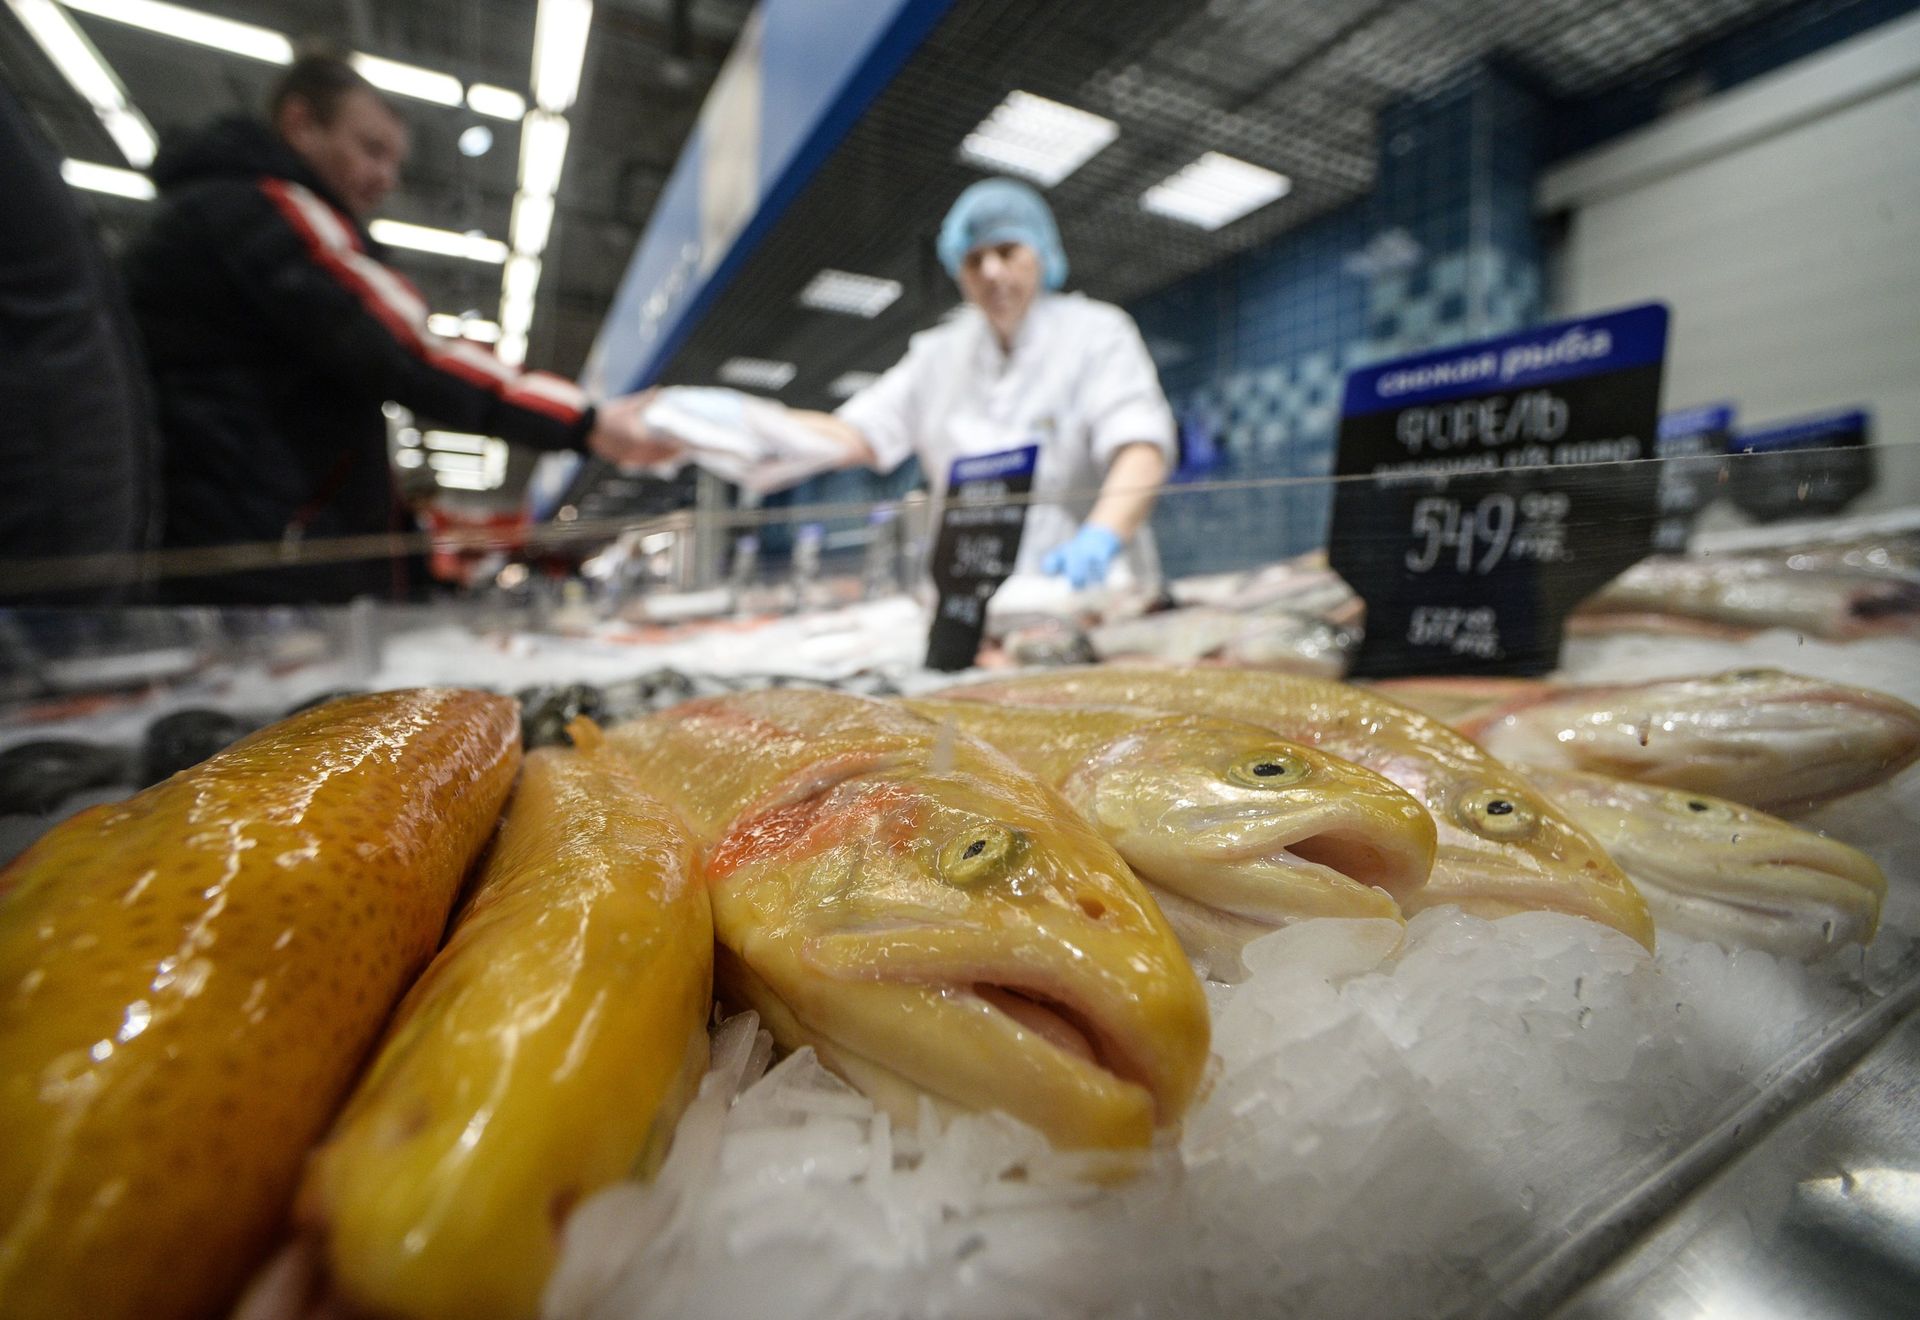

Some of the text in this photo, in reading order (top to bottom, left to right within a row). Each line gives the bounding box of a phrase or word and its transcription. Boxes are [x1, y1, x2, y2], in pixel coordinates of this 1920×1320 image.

[1377, 327, 1613, 396] свежая рыба
[1397, 389, 1569, 453] ФОРЕЛЬ
[1406, 493, 1515, 574] 549
